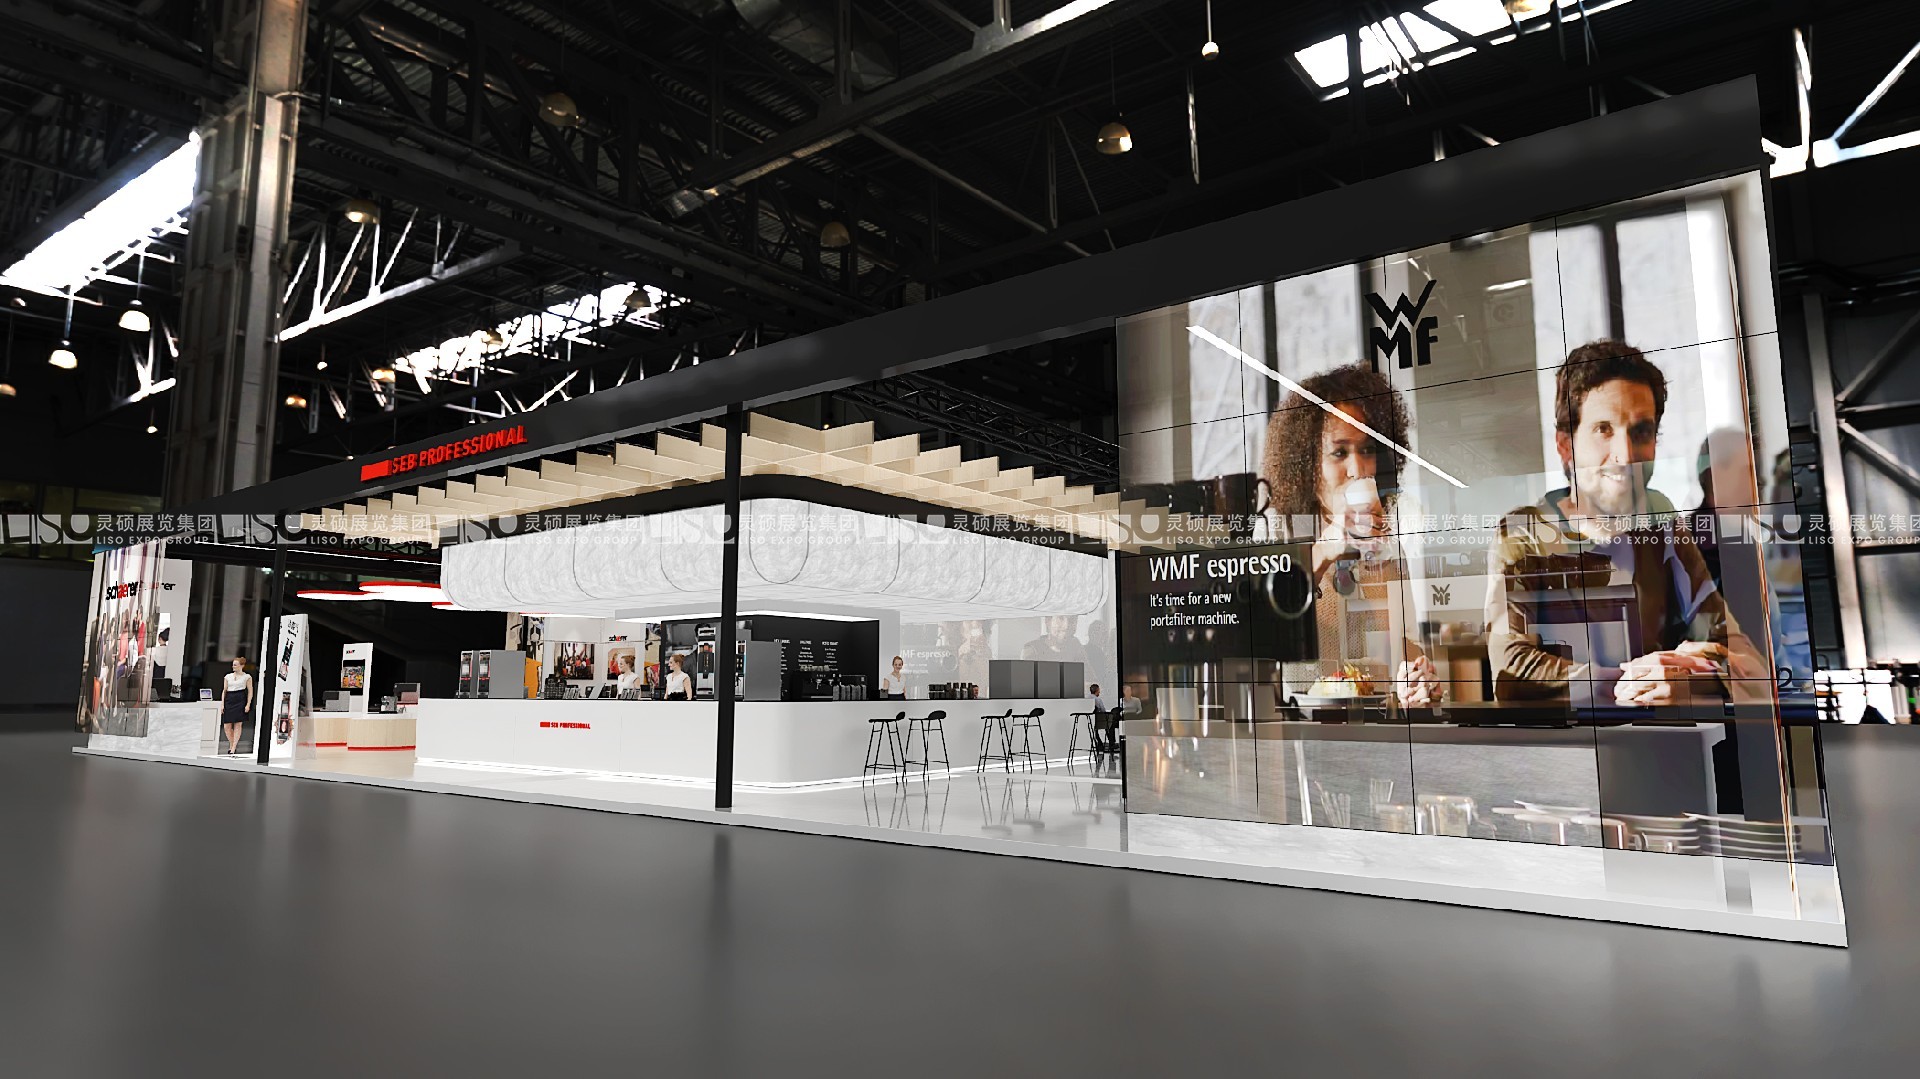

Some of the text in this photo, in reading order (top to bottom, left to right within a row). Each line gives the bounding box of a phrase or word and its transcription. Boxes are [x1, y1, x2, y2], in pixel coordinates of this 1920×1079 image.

[1364, 280, 1438, 372] WMF
[392, 425, 527, 474] SEB PROFESSIONAL
[1149, 553, 1291, 583] WMF espresso
[1150, 591, 1232, 608] It's time for a new
[1431, 583, 1451, 606] WMF
[1150, 610, 1240, 630] portafilter machine.
[900, 649, 915, 659] MF
